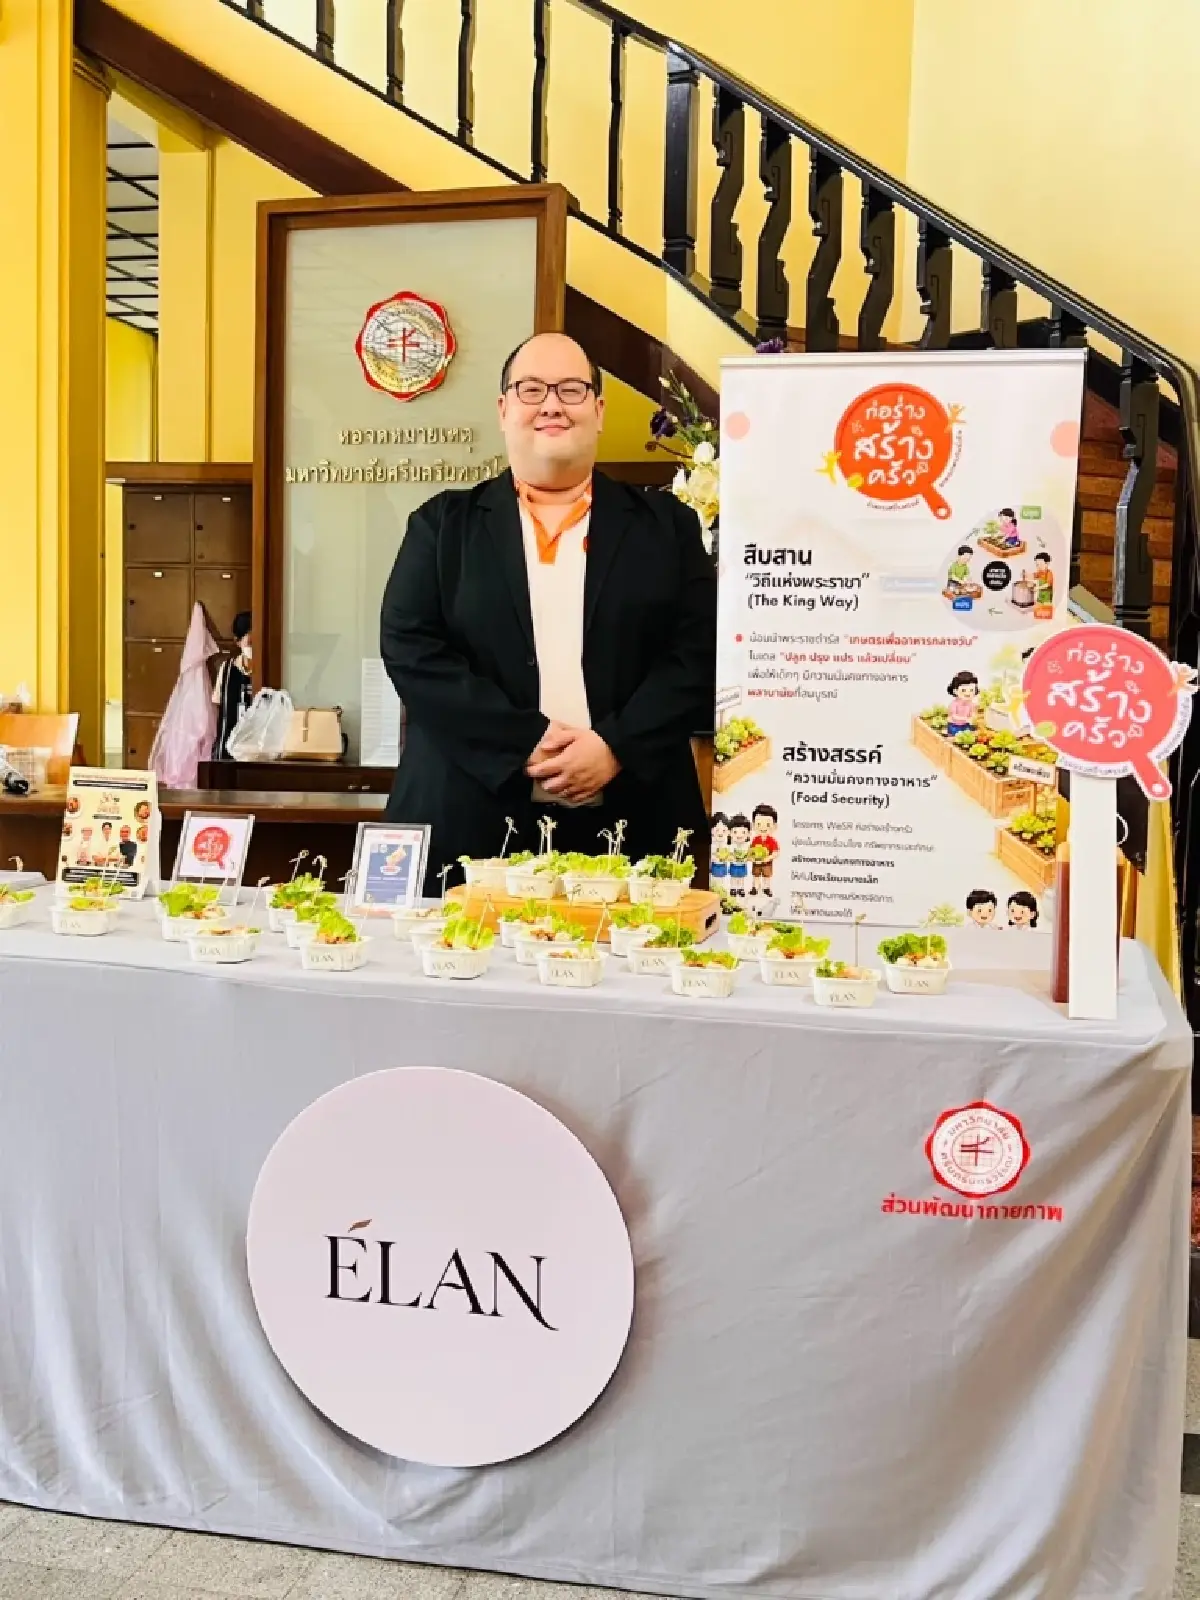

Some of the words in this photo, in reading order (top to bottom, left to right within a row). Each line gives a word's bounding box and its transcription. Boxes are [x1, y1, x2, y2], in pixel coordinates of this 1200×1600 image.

[866, 394, 926, 420] ก่อร่าง
[338, 427, 474, 453] หอจดหมายเหตุ
[854, 420, 934, 462] สร้าง
[867, 459, 917, 486] ครัว
[743, 543, 812, 565] สืบสาน
[748, 594, 778, 610] (The
[783, 594, 815, 611] King
[820, 595, 859, 611] Way)
[1067, 642, 1145, 675] ก่อร่าง
[1047, 669, 1153, 724] สร้าง
[1062, 715, 1128, 749] ครัว
[782, 741, 884, 764] สร้างสรรค์
[791, 791, 828, 806] (Food
[831, 793, 890, 809] Security)
[881, 1192, 1064, 1222] ส่วนพัฒนากายภาพ
[323, 1218, 559, 1332] ÉLAN
